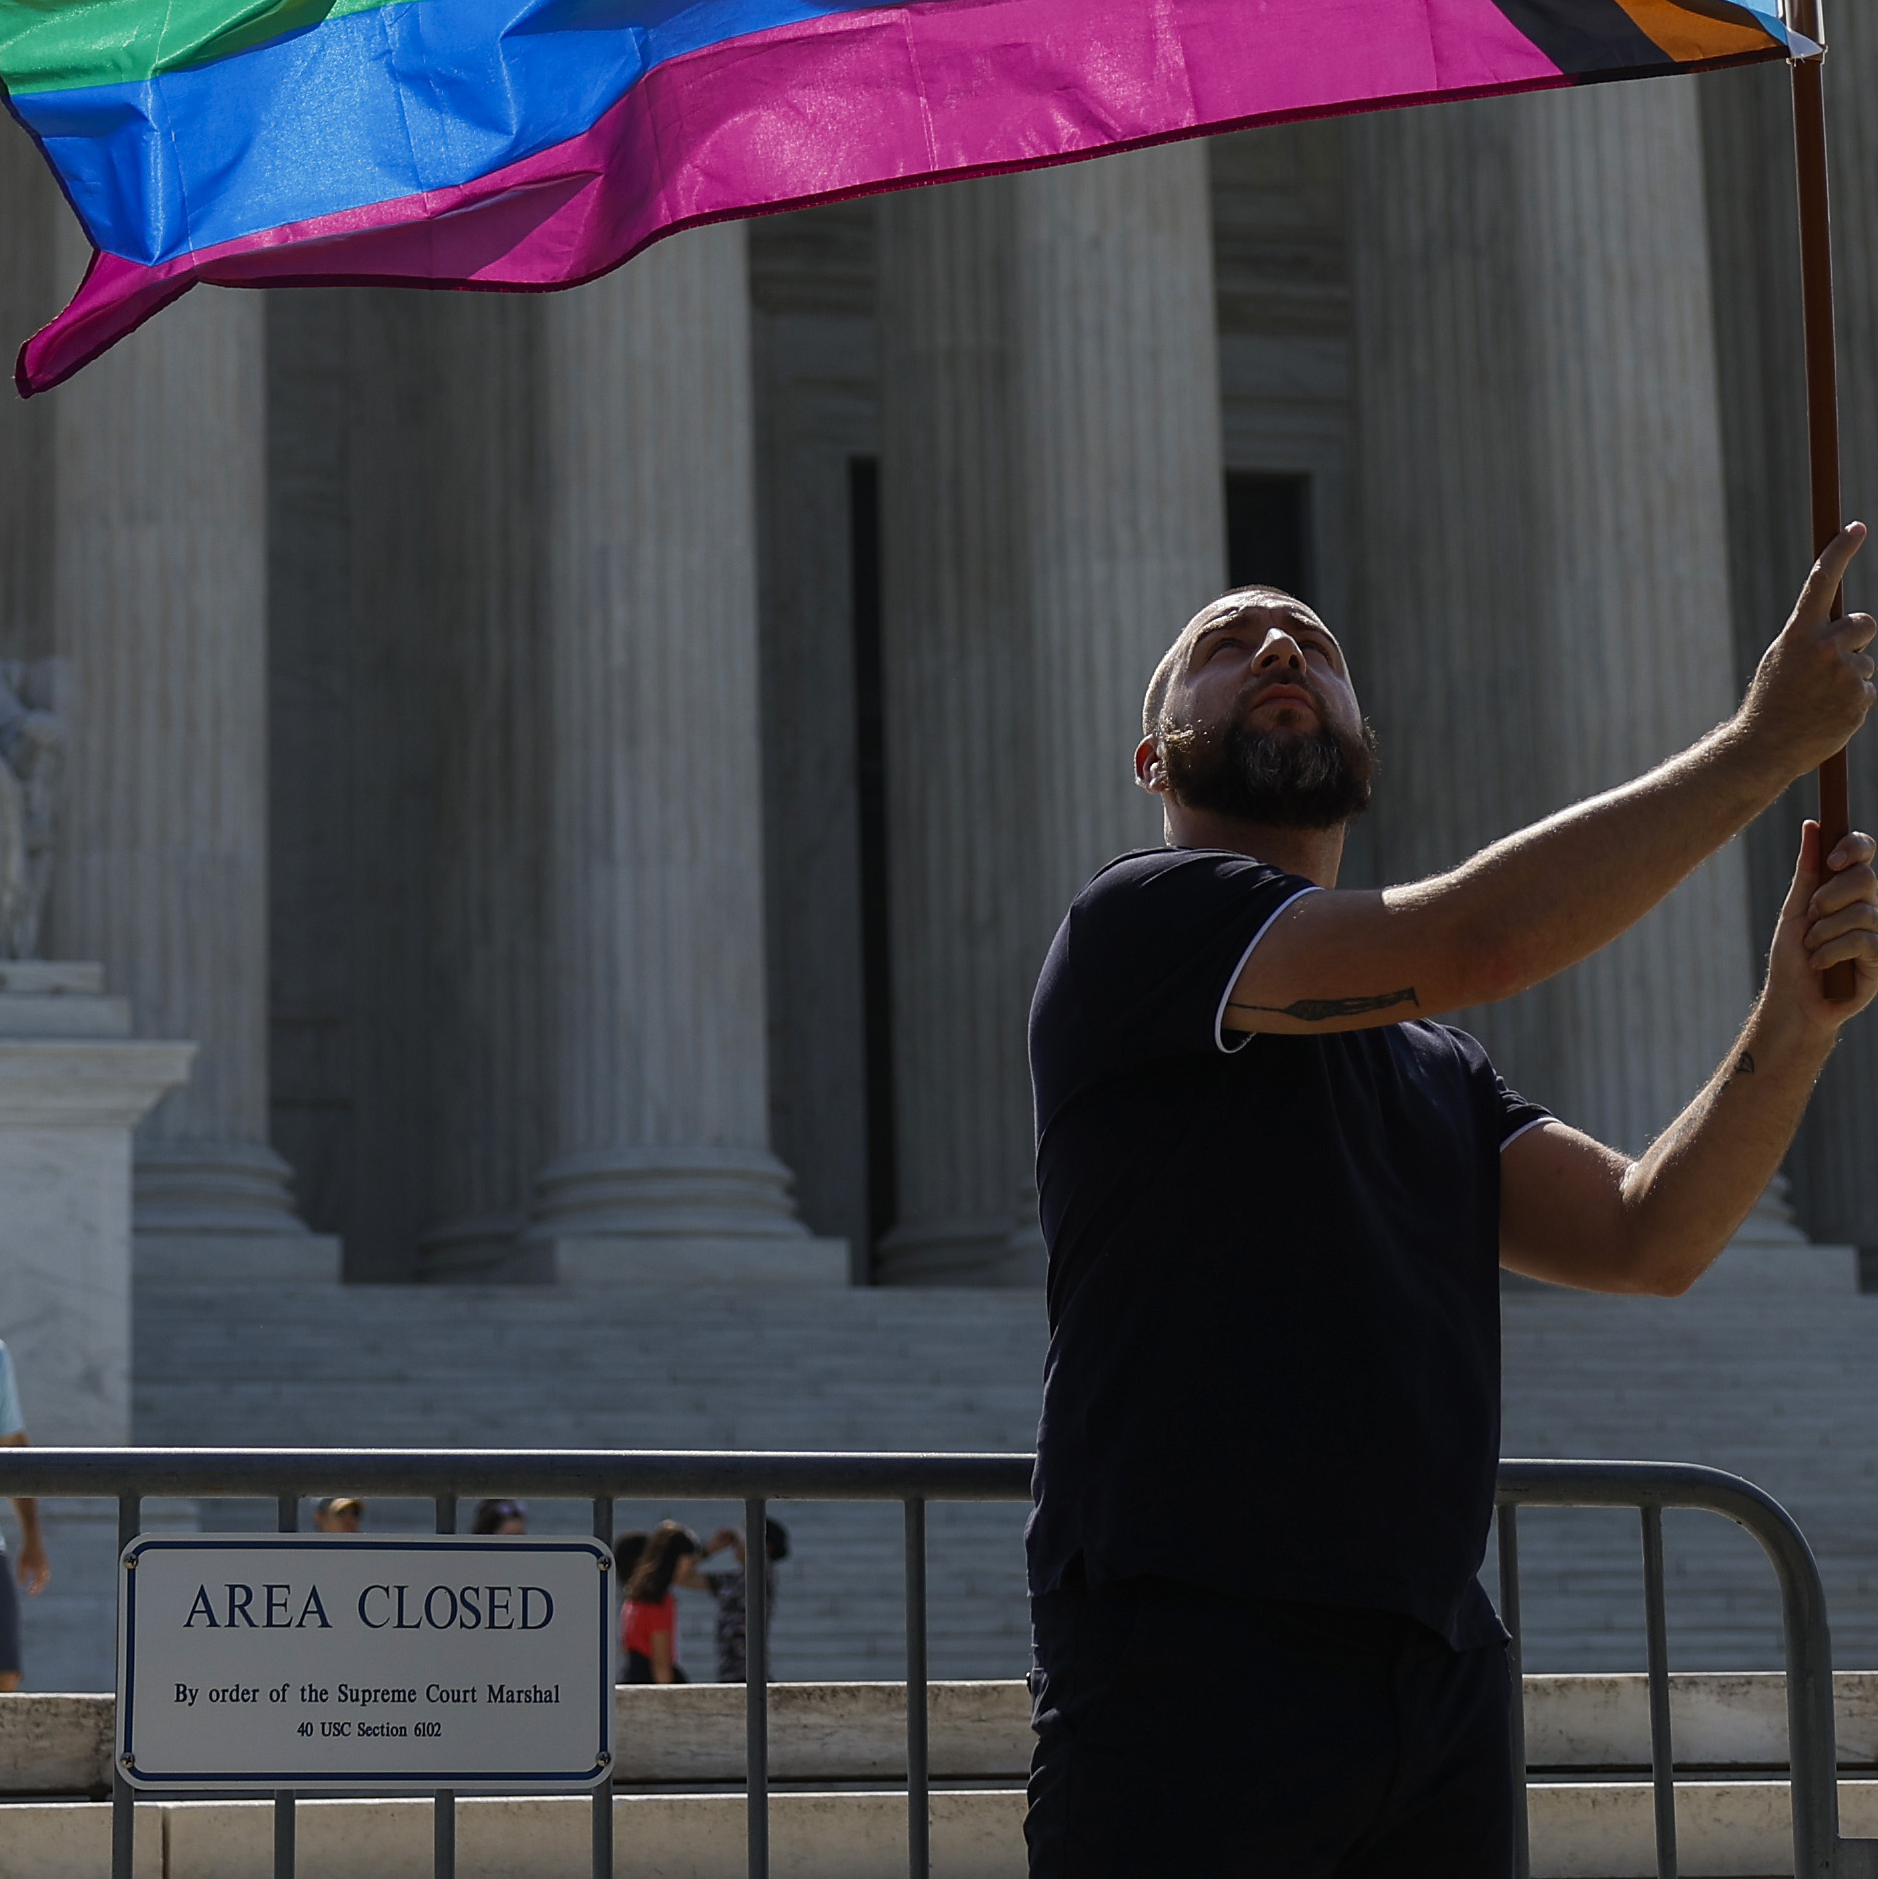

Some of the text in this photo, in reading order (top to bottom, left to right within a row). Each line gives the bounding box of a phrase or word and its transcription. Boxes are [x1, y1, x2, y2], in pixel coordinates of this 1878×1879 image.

[183, 1584, 554, 1630] AREA CLOSED
[174, 1683, 560, 1707] By order of the Supreme Court Marshal
[297, 1721, 442, 1737] 40 USC Section 6102
